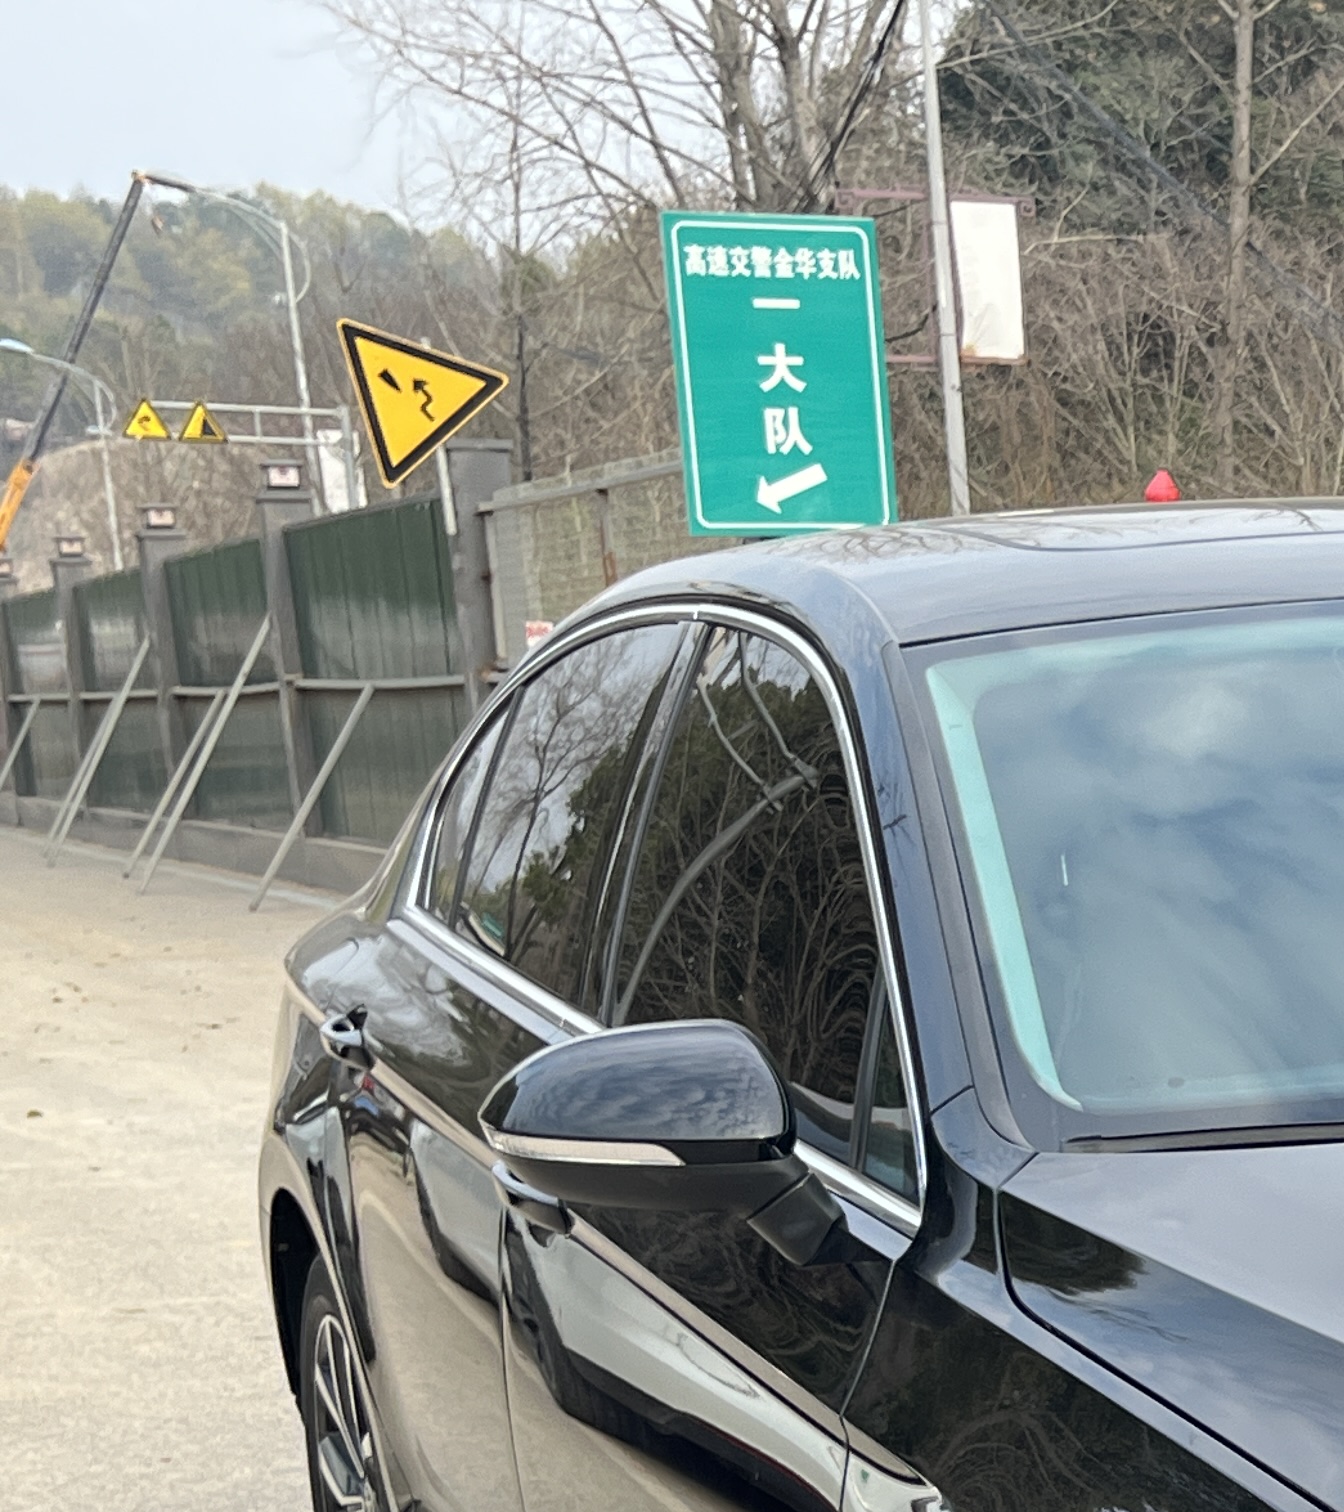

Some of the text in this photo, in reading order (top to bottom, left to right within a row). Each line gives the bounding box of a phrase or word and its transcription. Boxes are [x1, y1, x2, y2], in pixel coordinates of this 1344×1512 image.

[683, 244, 860, 280] 高速交警金华支队
[752, 297, 813, 456] 一大队
